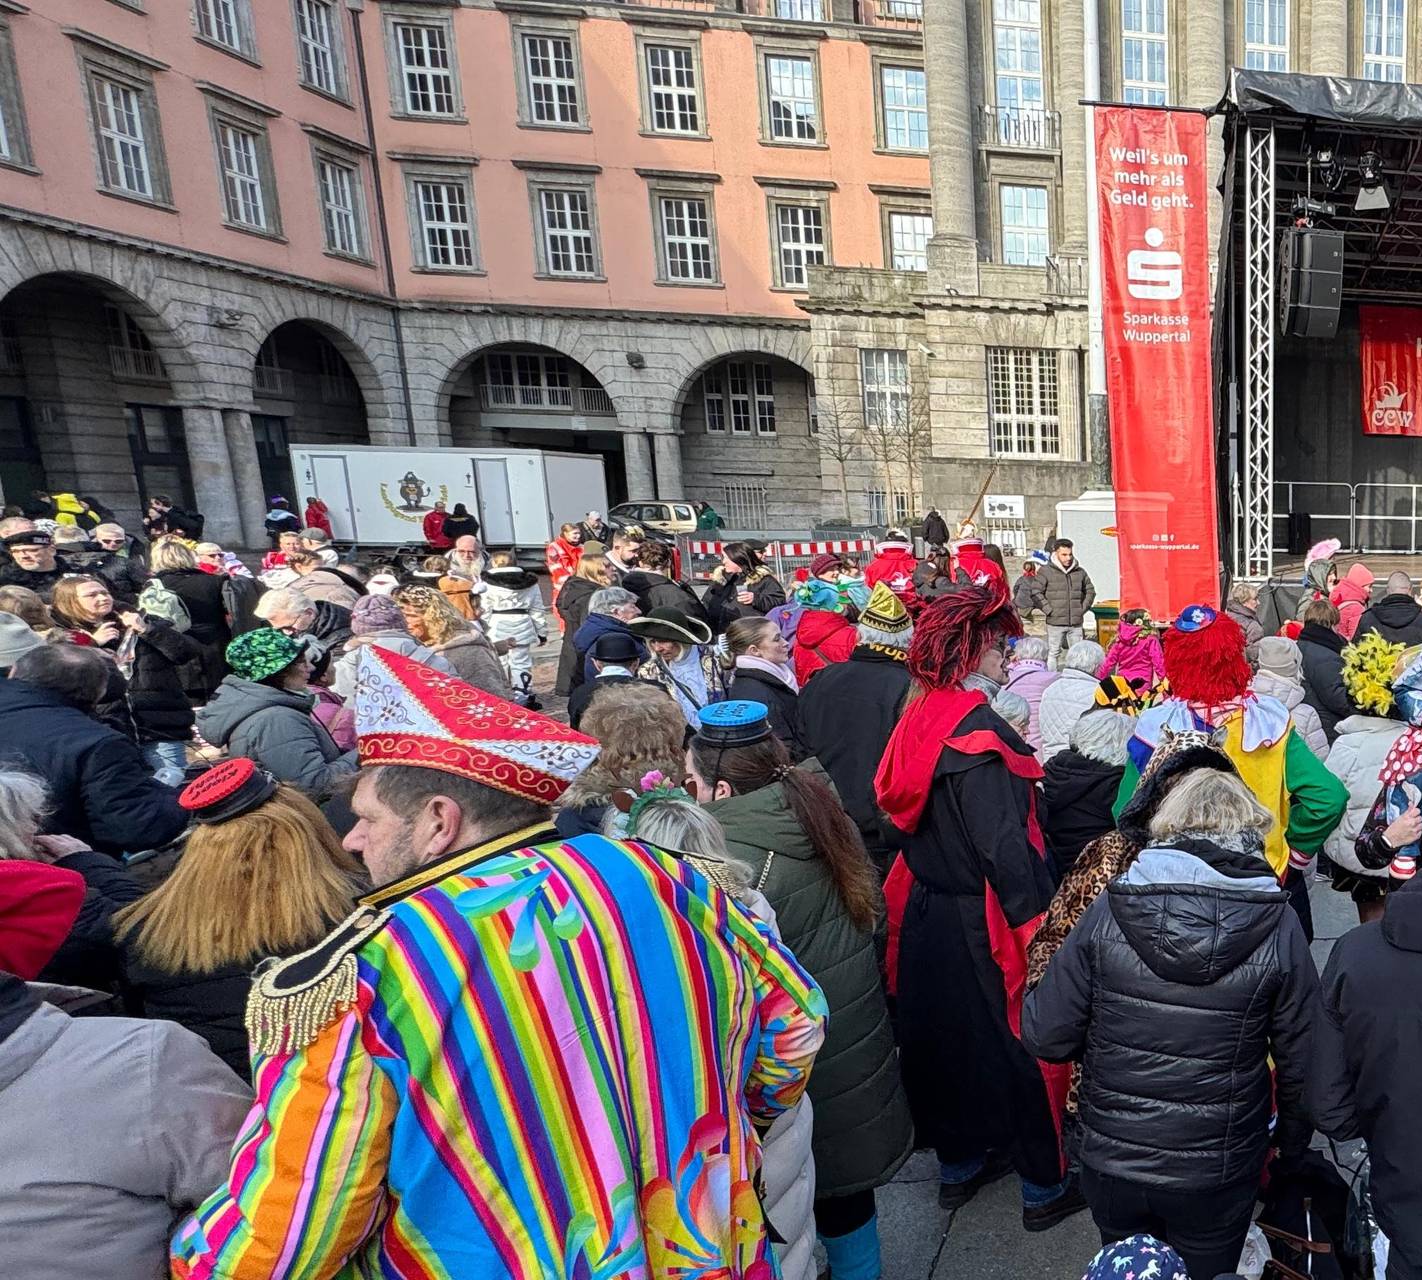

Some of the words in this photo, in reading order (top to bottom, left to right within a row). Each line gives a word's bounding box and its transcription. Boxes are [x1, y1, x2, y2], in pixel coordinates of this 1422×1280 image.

[1109, 147, 1160, 165] Weil's
[1163, 153, 1188, 166] um
[1114, 170, 1157, 186] mehr
[1161, 172, 1185, 186] als
[1110, 190, 1147, 207] Geld
[1151, 193, 1194, 211] geht.
[1123, 312, 1189, 327] Sparkasse
[1123, 329, 1190, 343] Wuppertal
